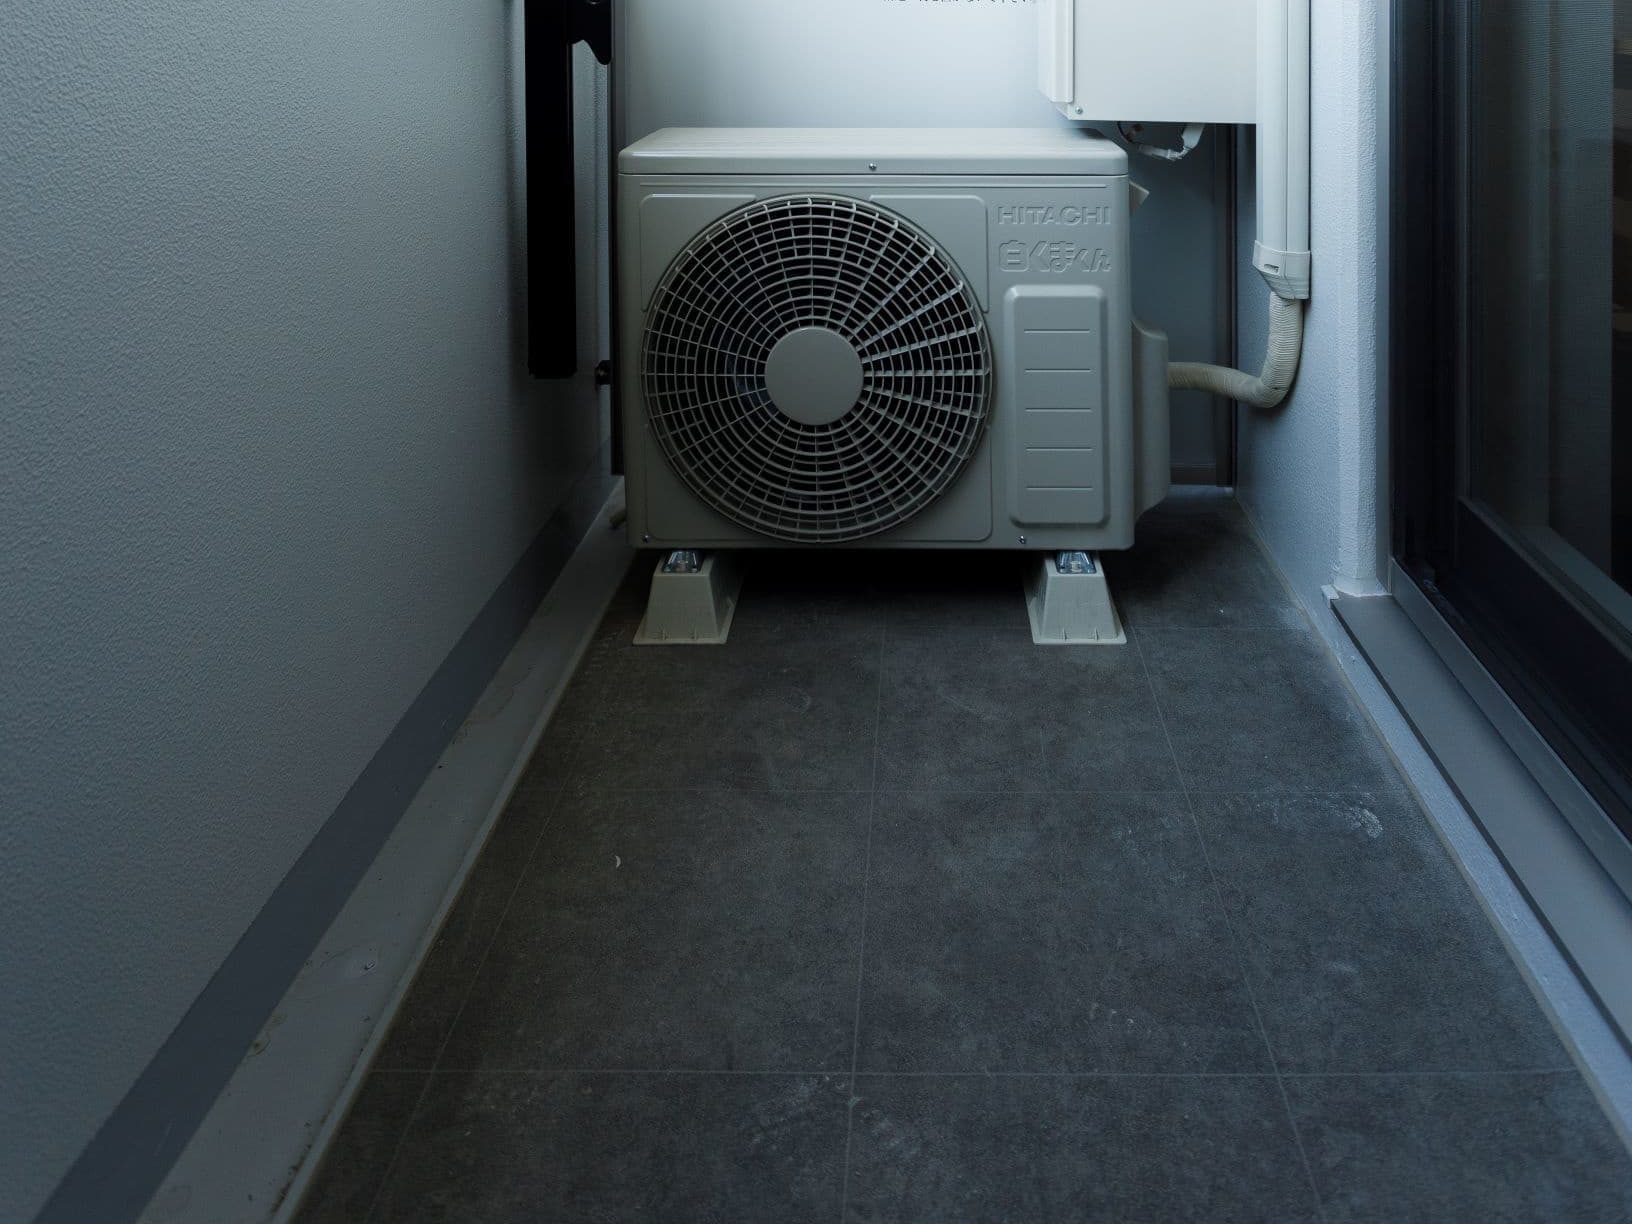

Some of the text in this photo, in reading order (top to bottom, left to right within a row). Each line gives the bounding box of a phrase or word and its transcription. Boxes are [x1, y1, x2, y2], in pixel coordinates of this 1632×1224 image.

[998, 206, 1112, 225] HITACHI
[999, 239, 1112, 273] 白くまくん
